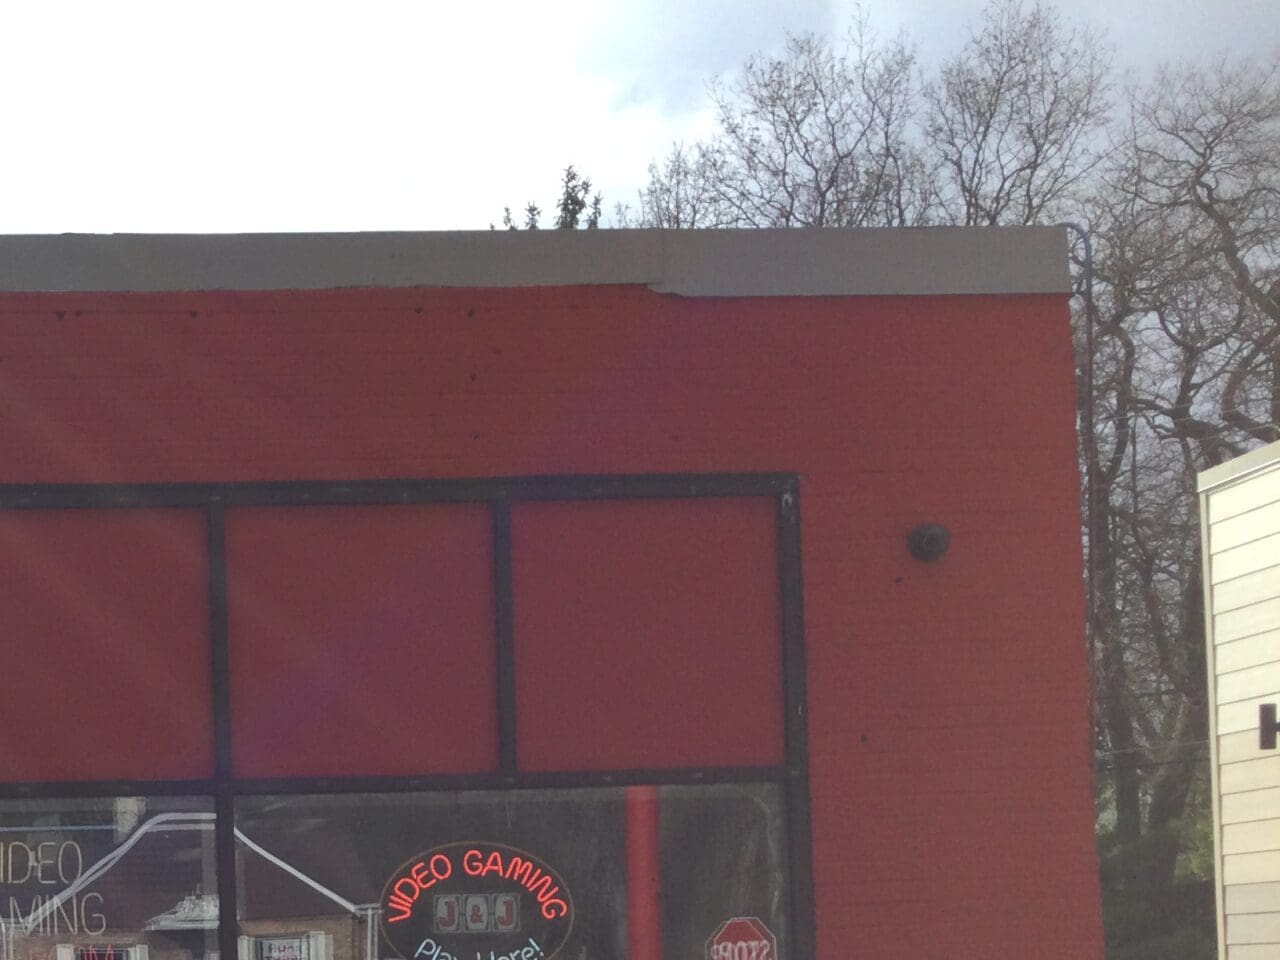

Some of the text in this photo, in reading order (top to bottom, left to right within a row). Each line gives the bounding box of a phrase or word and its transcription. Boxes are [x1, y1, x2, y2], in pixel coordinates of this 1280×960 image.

[387, 849, 568, 923] VIDEO GAMING
[439, 900, 456, 928] J
[497, 900, 514, 928] J
